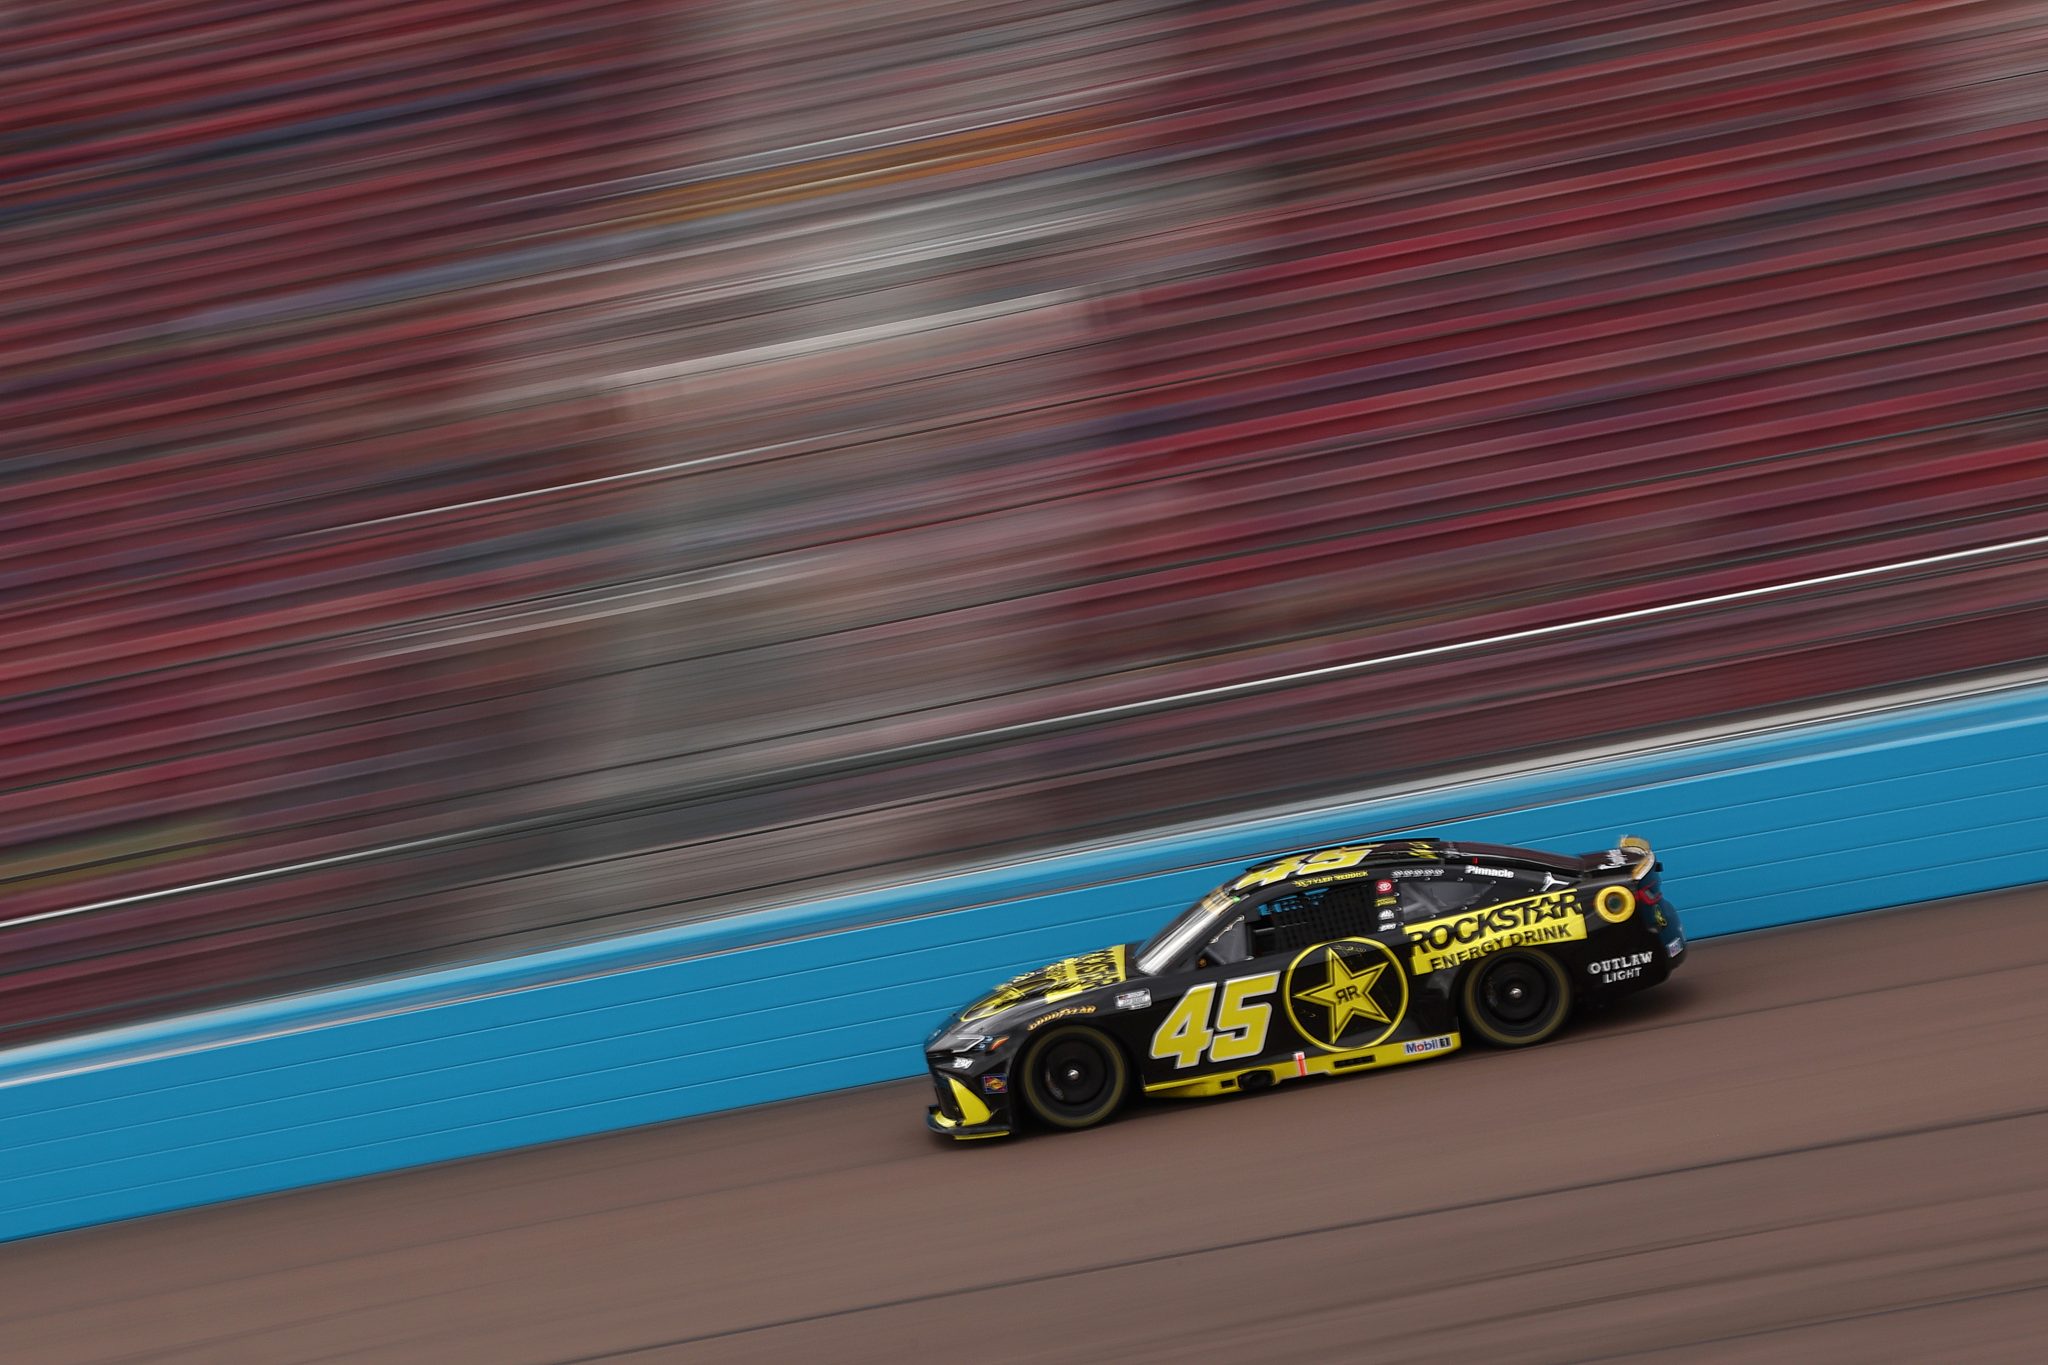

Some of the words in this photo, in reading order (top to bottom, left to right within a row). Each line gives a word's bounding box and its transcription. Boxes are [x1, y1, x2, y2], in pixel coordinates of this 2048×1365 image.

[1465, 865, 1514, 879] Pinnacle
[1408, 892, 1583, 955] ROCKSTAR
[1430, 937, 1508, 971] ENERGY
[1509, 923, 1572, 947] DRINK
[1587, 951, 1653, 975] OUTLAW
[1602, 967, 1642, 984] LIGHT
[1150, 970, 1281, 1070] 45
[1406, 1039, 1438, 1053] Mobil
